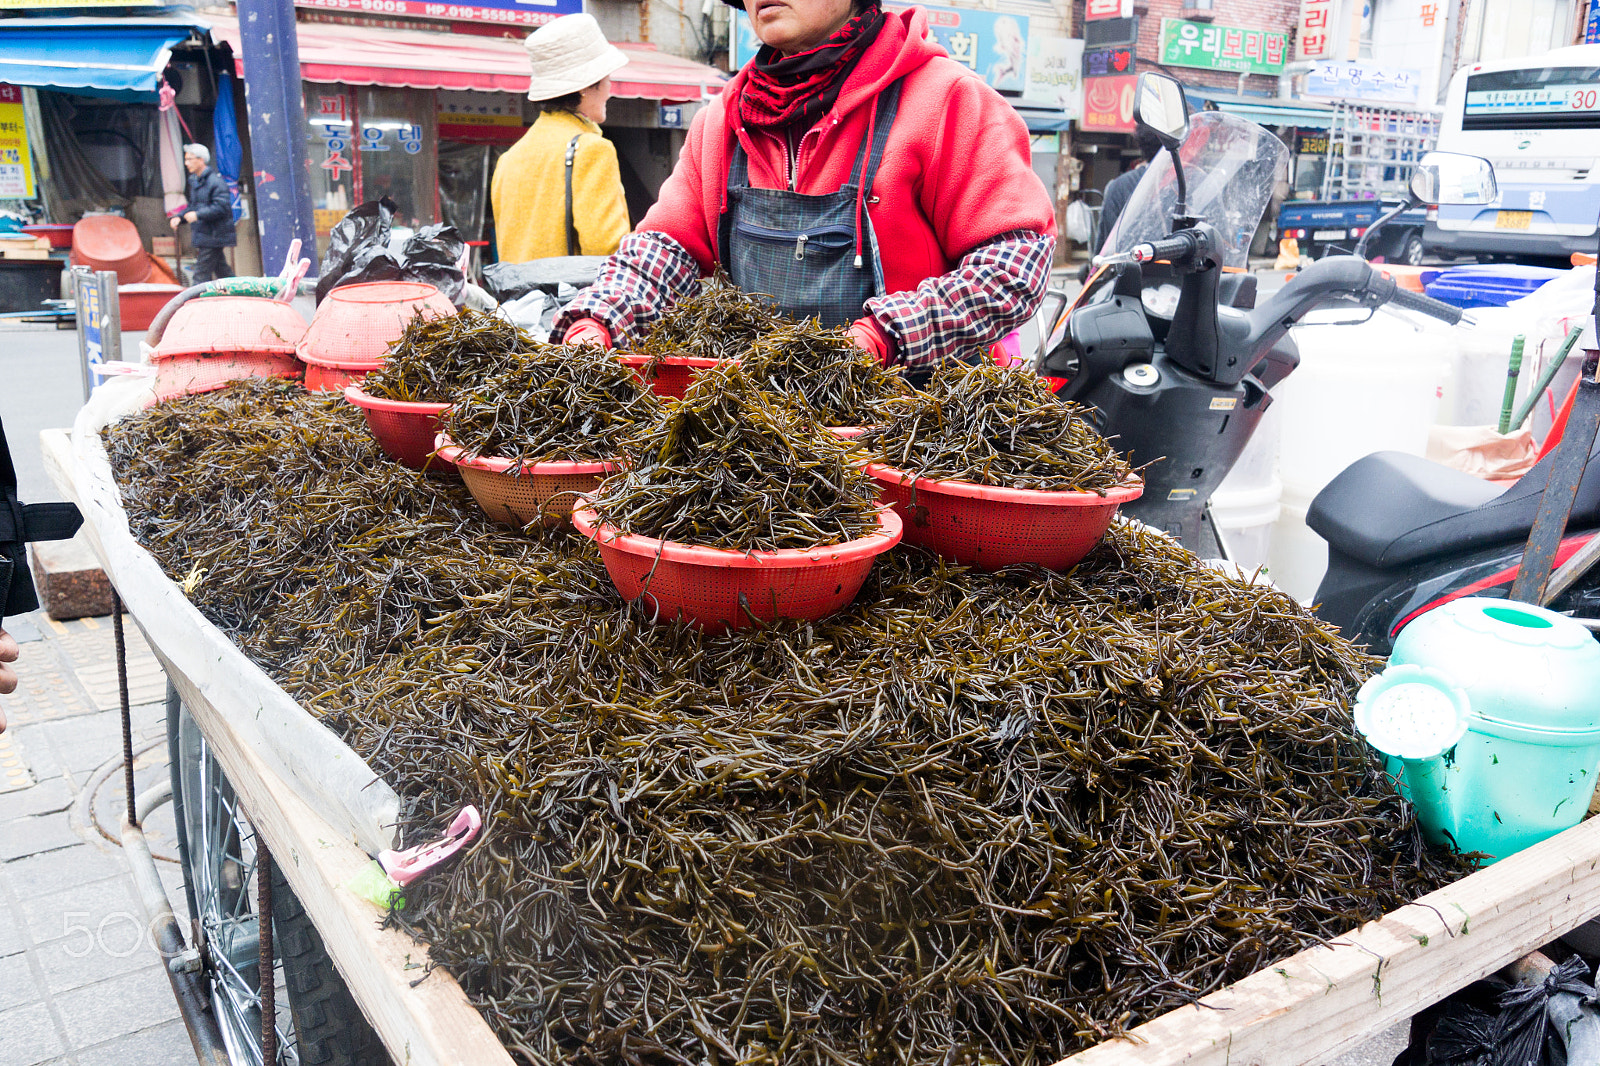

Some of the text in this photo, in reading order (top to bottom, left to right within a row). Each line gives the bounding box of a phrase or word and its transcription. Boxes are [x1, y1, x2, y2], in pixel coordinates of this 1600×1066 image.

[1303, 0, 1330, 55] 리밥
[1178, 24, 1285, 65] 우리보리밥
[1324, 66, 1410, 89] 진명수산
[1572, 90, 1597, 109] 30
[321, 124, 422, 155] 동 오뎅
[320, 152, 353, 181] 수
